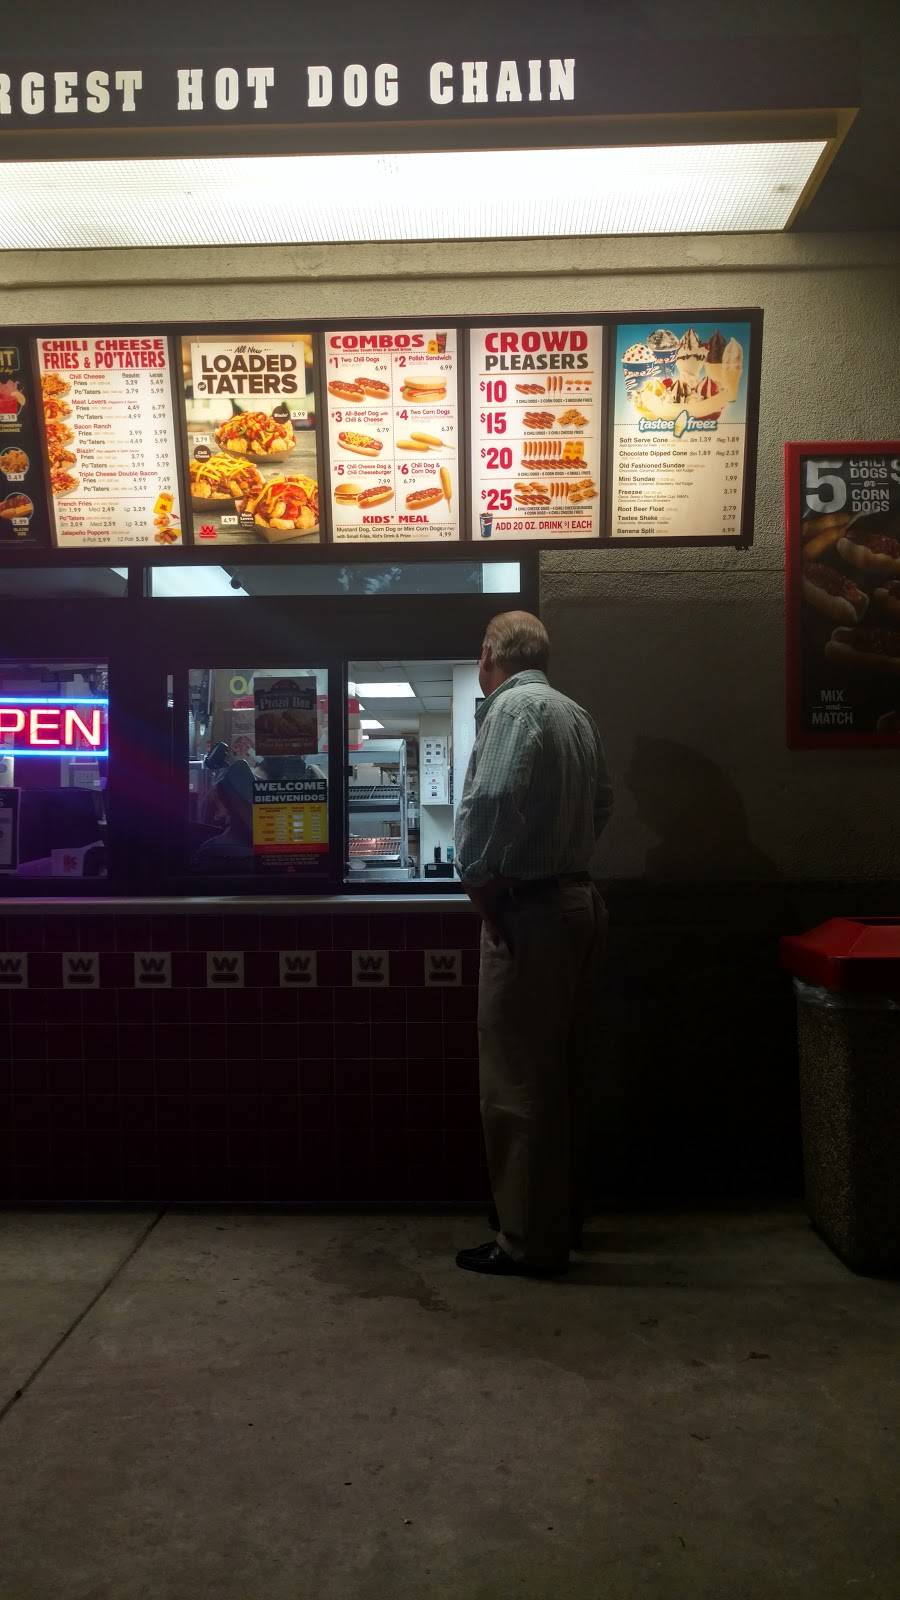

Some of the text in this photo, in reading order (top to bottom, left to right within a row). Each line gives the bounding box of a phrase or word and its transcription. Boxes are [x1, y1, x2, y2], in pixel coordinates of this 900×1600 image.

[177, 67, 274, 111] HOT
[307, 63, 398, 108] DOG
[429, 59, 576, 105] CHAIN
[43, 339, 163, 351] CHILI CHEESE
[330, 334, 424, 348] COMBOS
[485, 331, 588, 353] CROWD
[44, 351, 165, 369] FRIES & PO'TATERS
[202, 355, 297, 372] LOADED
[485, 353, 589, 371] PLEASERS
[202, 374, 297, 394] TATERS
[480, 380, 507, 402] $10
[480, 413, 506, 434] $15
[641, 418, 716, 430] tastee freez
[480, 447, 512, 469] $20
[850, 468, 887, 478] DOGS
[806, 461, 846, 513] 5
[852, 490, 889, 500] CORN
[481, 489, 512, 511] $25
[853, 501, 889, 511] DOGS
[821, 690, 844, 701] MIX
[812, 712, 853, 724] MATCH
[255, 782, 325, 791] WELCOME
[255, 794, 324, 802] BIENVENIDOS
